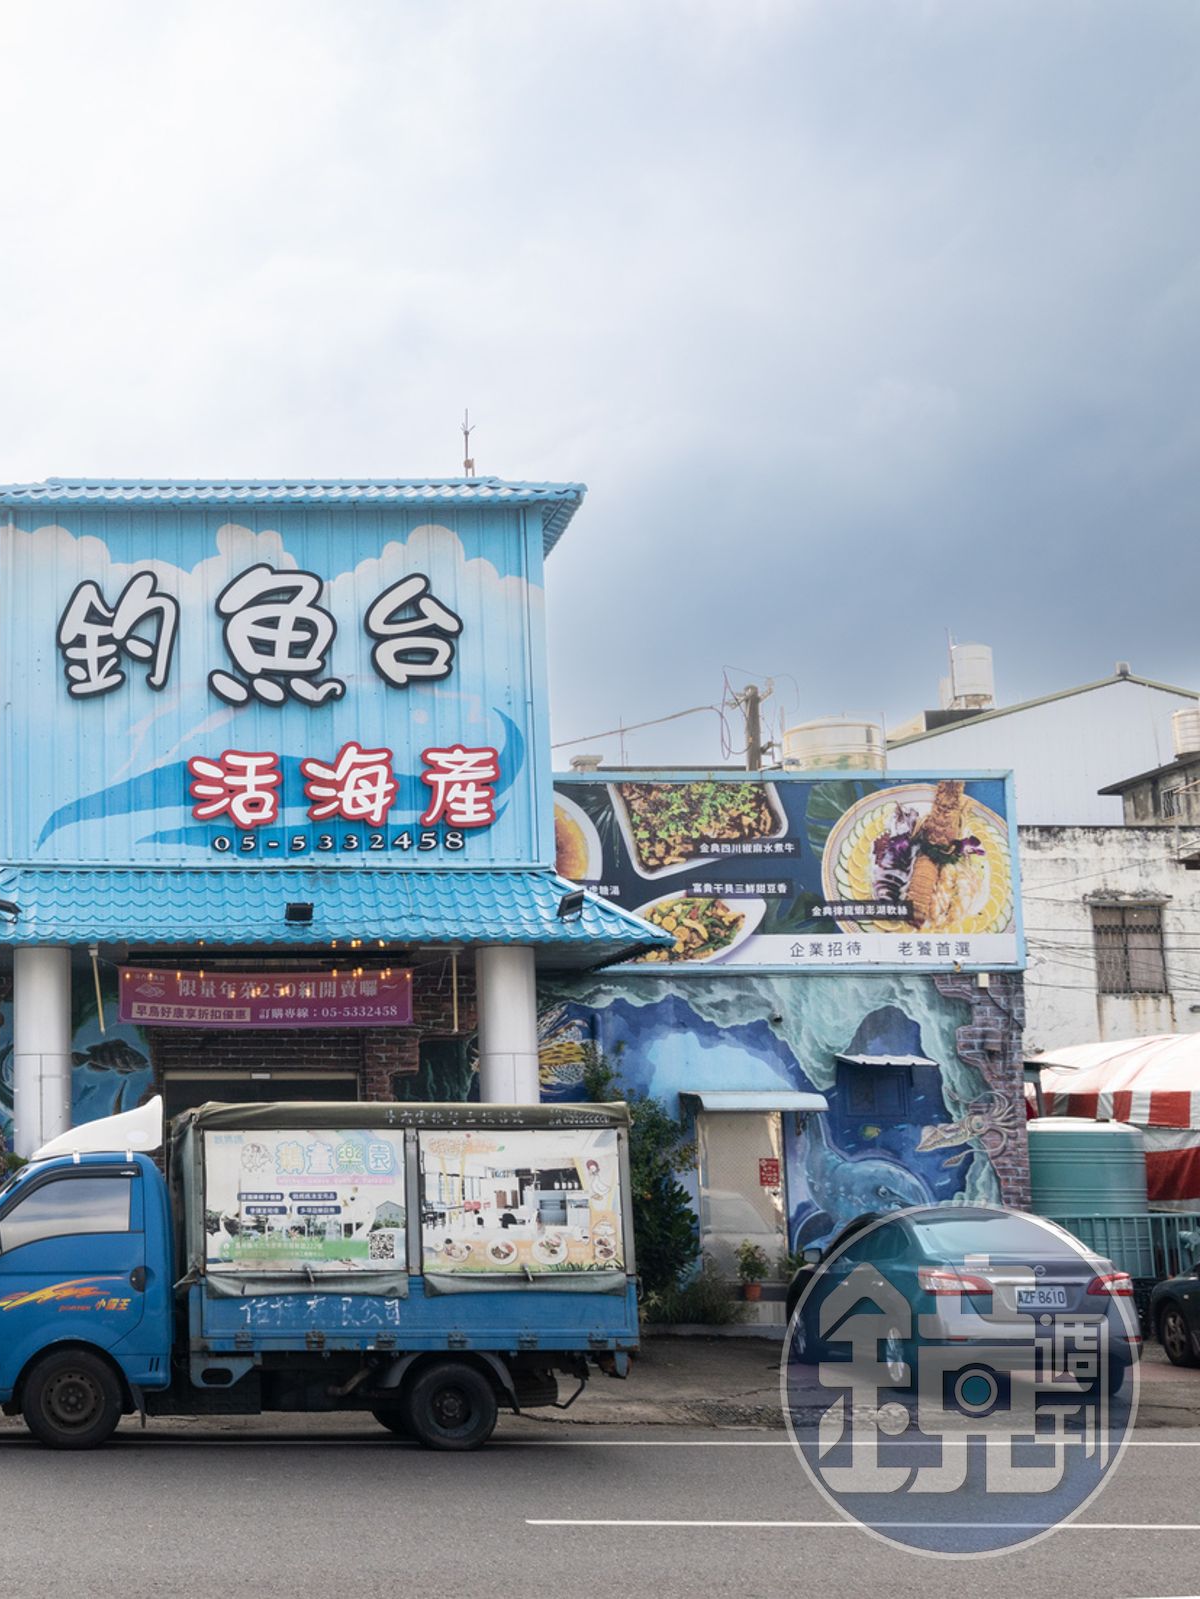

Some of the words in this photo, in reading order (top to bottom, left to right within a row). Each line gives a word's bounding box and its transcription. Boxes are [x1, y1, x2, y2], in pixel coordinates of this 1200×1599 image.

[57, 563, 463, 708] 釣魚台
[188, 740, 501, 829] 活海產
[213, 831, 466, 853] 05-5332458
[790, 942, 862, 957] 企業招待
[897, 941, 971, 957] 老饕首選
